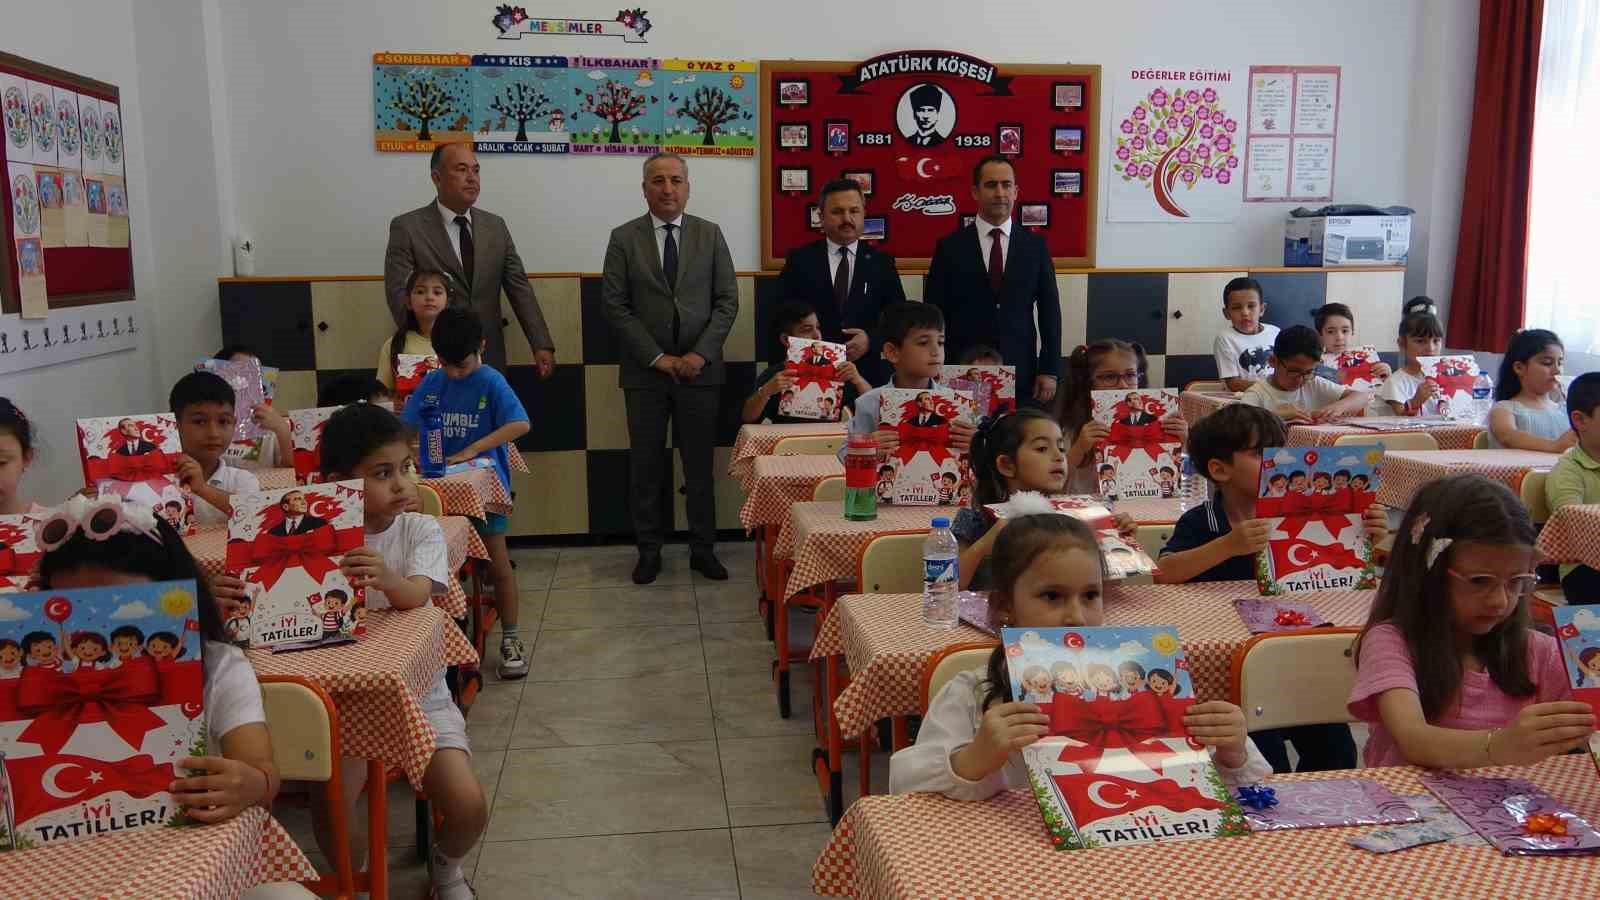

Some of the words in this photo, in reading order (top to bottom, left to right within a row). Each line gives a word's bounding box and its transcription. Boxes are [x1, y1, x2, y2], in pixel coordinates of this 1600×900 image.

[384, 54, 459, 64] SONBAHAR
[698, 63, 723, 71] YAZ
[860, 54, 932, 82] ATATÜRK
[937, 56, 994, 83] KÖŞESİ
[1131, 68, 1186, 80] DEĞERLER
[857, 134, 892, 145] 1881
[955, 136, 991, 146] 1938
[478, 143, 504, 152] ARALIK
[513, 144, 533, 152] OCAK
[573, 144, 594, 152] MART
[281, 615, 297, 627] İYİ
[261, 624, 318, 642] TATİLLER!
[82, 799, 111, 819] İYİ
[35, 806, 167, 841] TATİLLER!
[1130, 811, 1159, 826] İYİ
[1096, 819, 1210, 842] TATİLLER!
